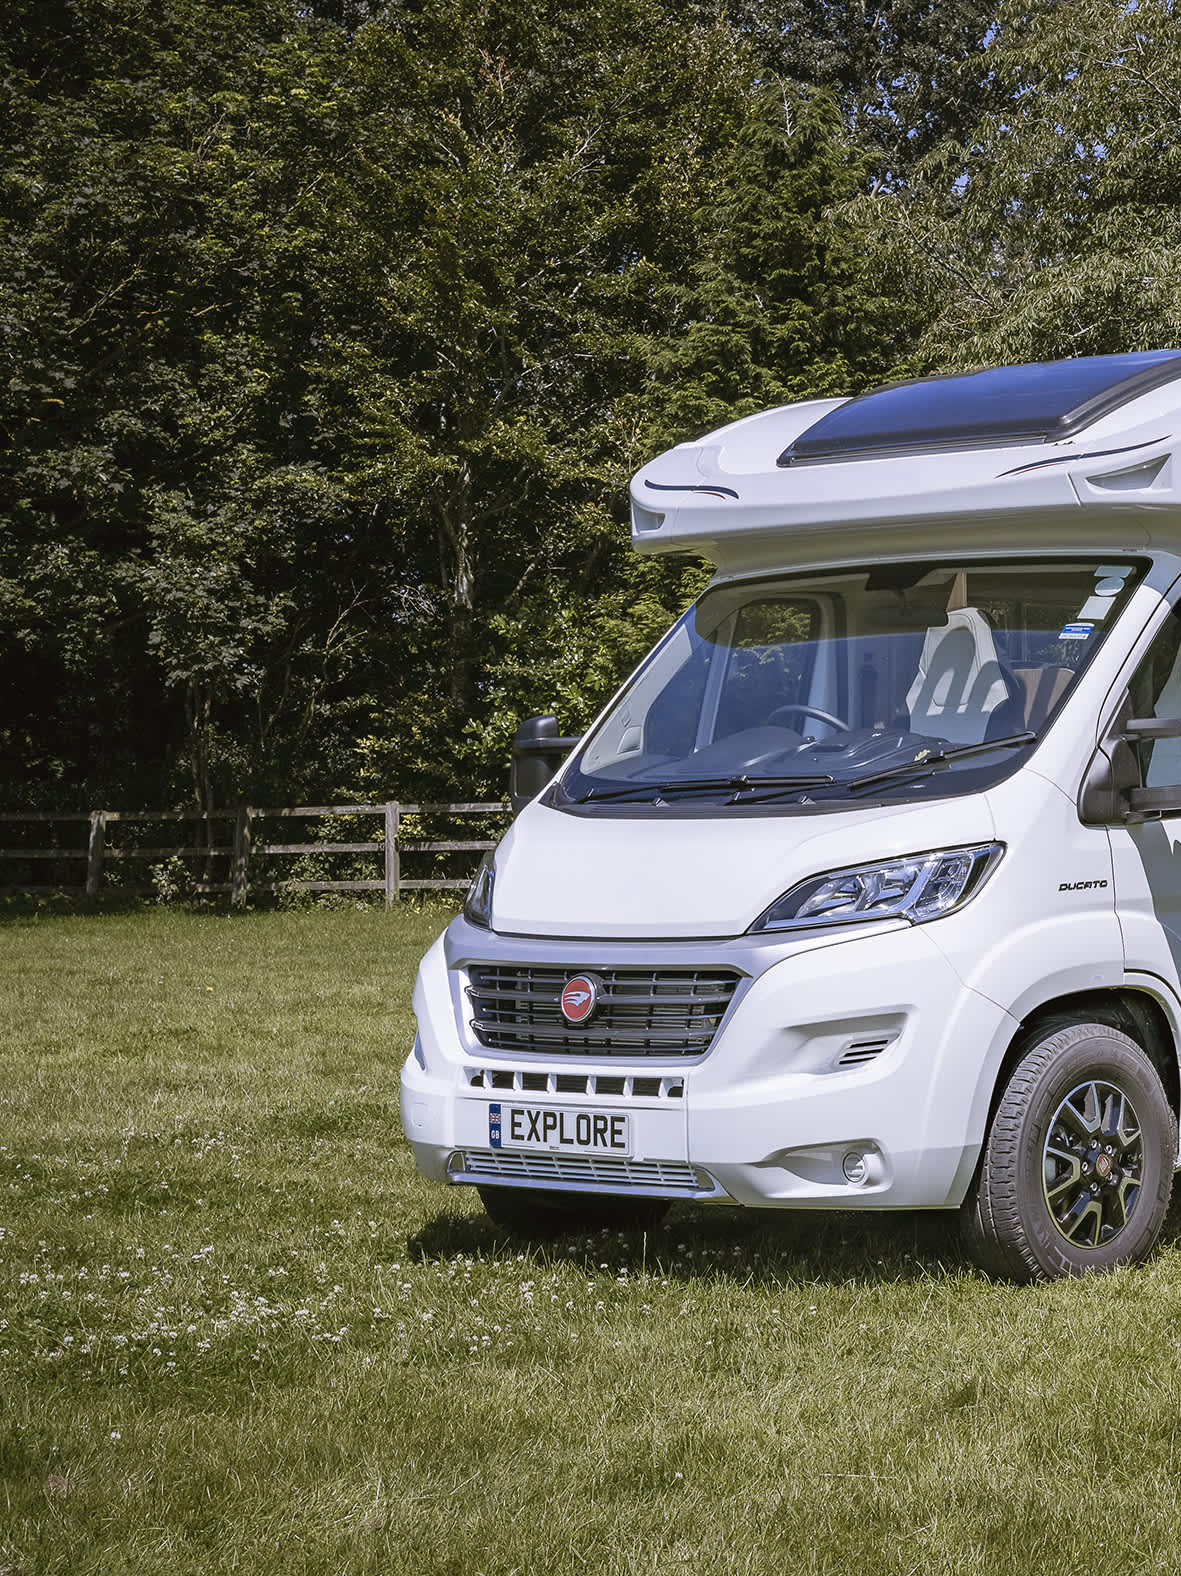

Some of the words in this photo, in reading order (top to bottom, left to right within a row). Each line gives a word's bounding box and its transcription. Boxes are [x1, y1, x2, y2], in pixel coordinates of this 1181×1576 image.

[1058, 880, 1108, 892] DUCATO
[490, 1130, 500, 1139] GB
[510, 1109, 626, 1149] EXPLORE
